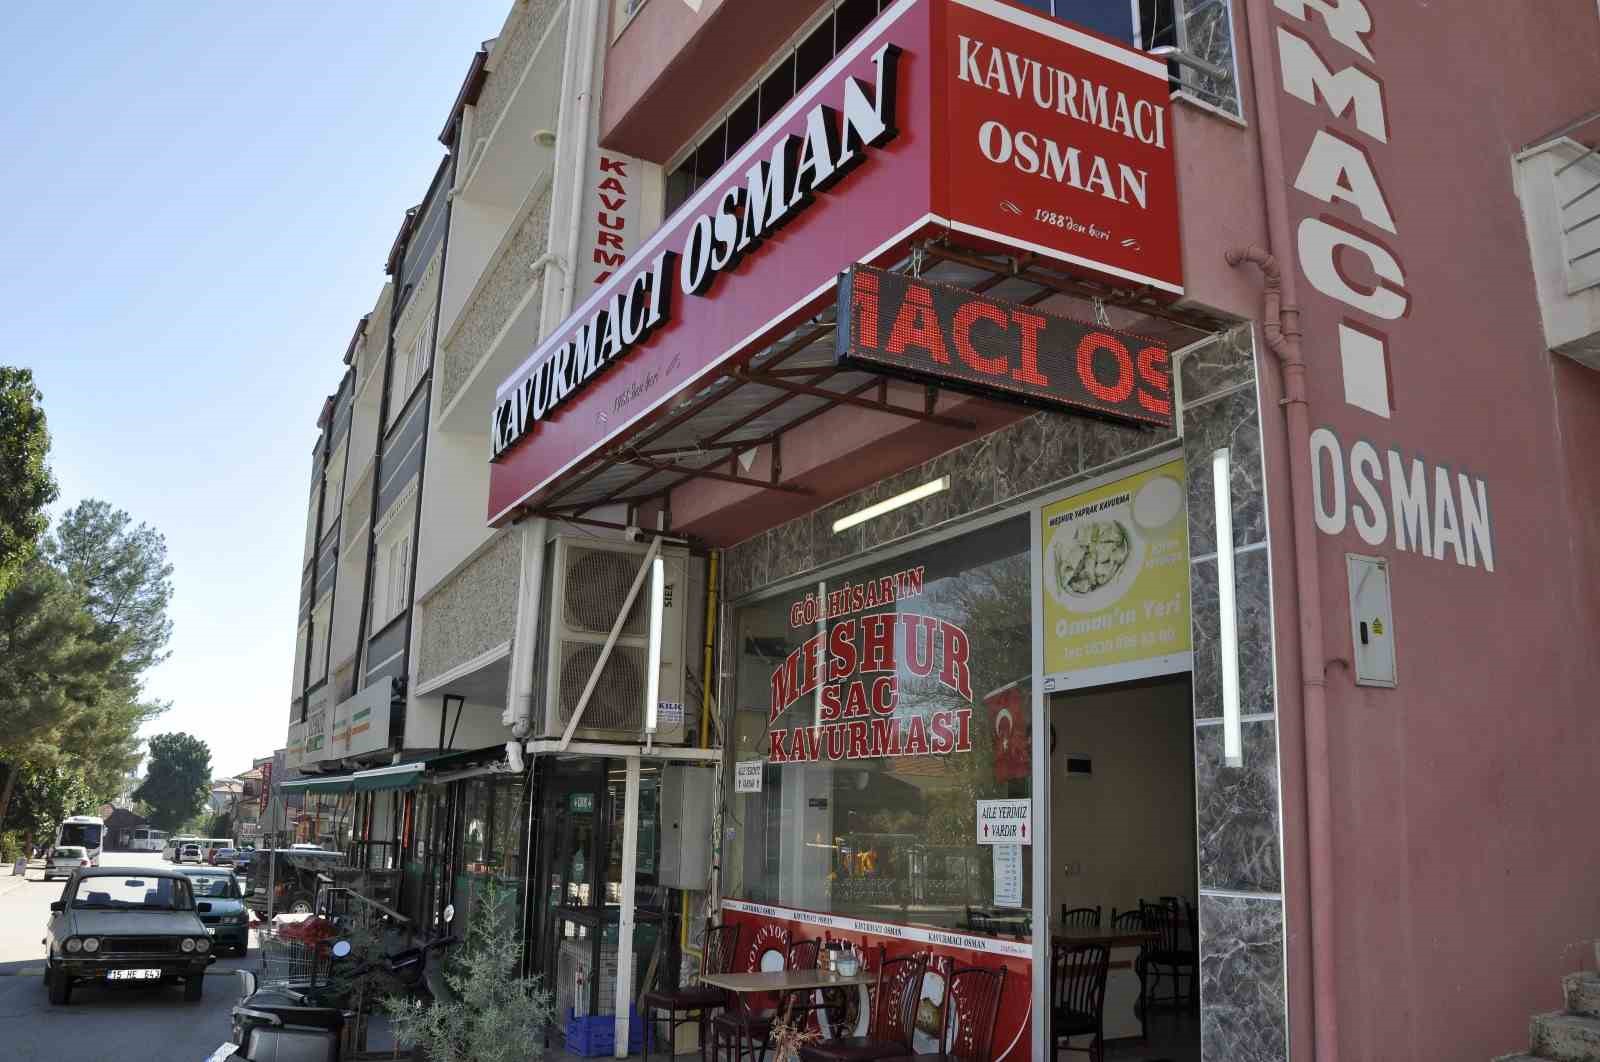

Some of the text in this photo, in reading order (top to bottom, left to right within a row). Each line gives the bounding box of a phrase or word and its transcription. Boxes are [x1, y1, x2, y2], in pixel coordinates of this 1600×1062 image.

[957, 35, 1166, 149] KAVURMACI
[978, 120, 1148, 209] OSMAN
[490, 42, 897, 463] KAVURMACI OSMAN
[1310, 428, 1494, 572] OSMAN
[768, 708, 972, 764] KAVURMASI
